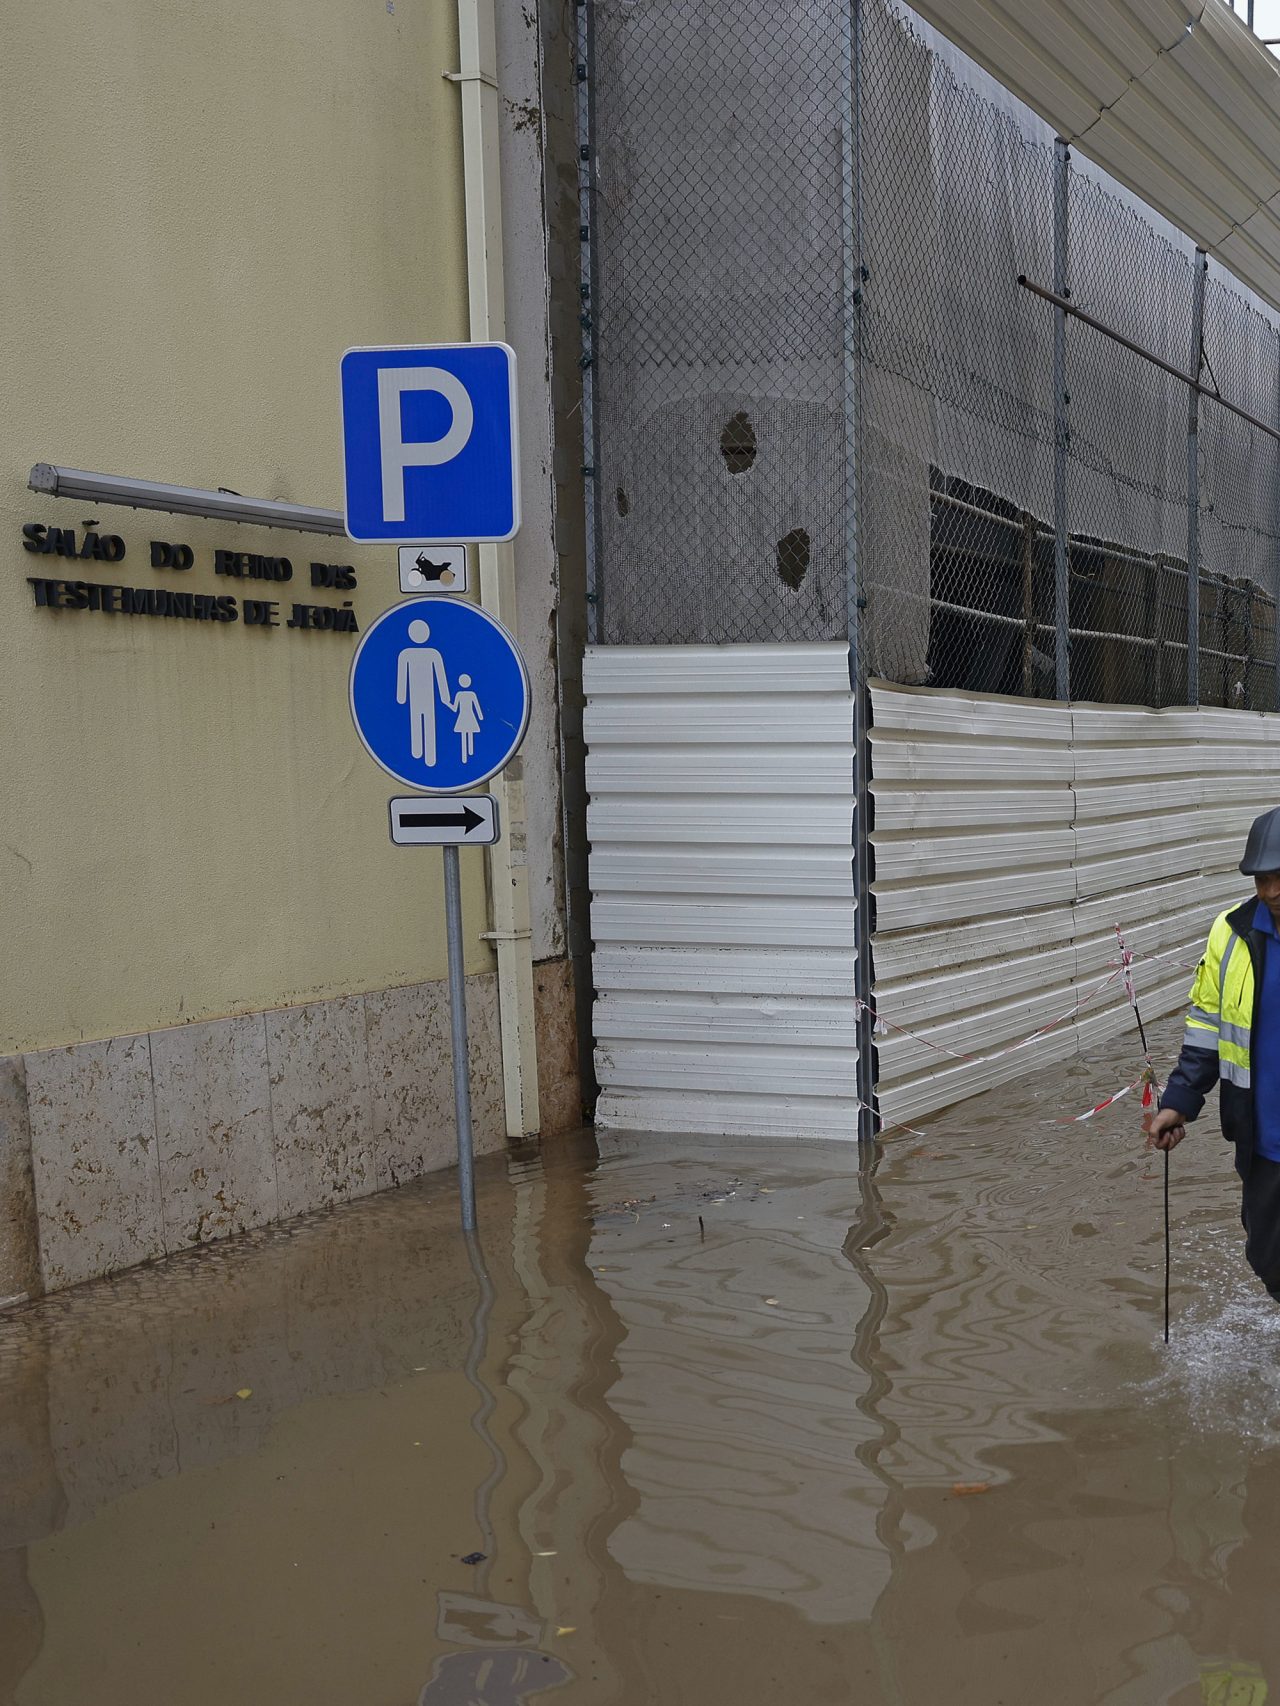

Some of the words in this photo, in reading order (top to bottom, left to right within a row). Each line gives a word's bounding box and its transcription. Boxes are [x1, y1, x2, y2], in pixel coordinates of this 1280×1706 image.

[377, 366, 474, 522] P
[22, 519, 126, 562] SALÃO
[150, 541, 195, 570] DO
[215, 550, 293, 581] REINO
[310, 563, 358, 590] DAS
[26, 577, 239, 622] TESTEMUNHAS
[243, 600, 281, 627] DE
[286, 601, 360, 633] JEOVÁ
